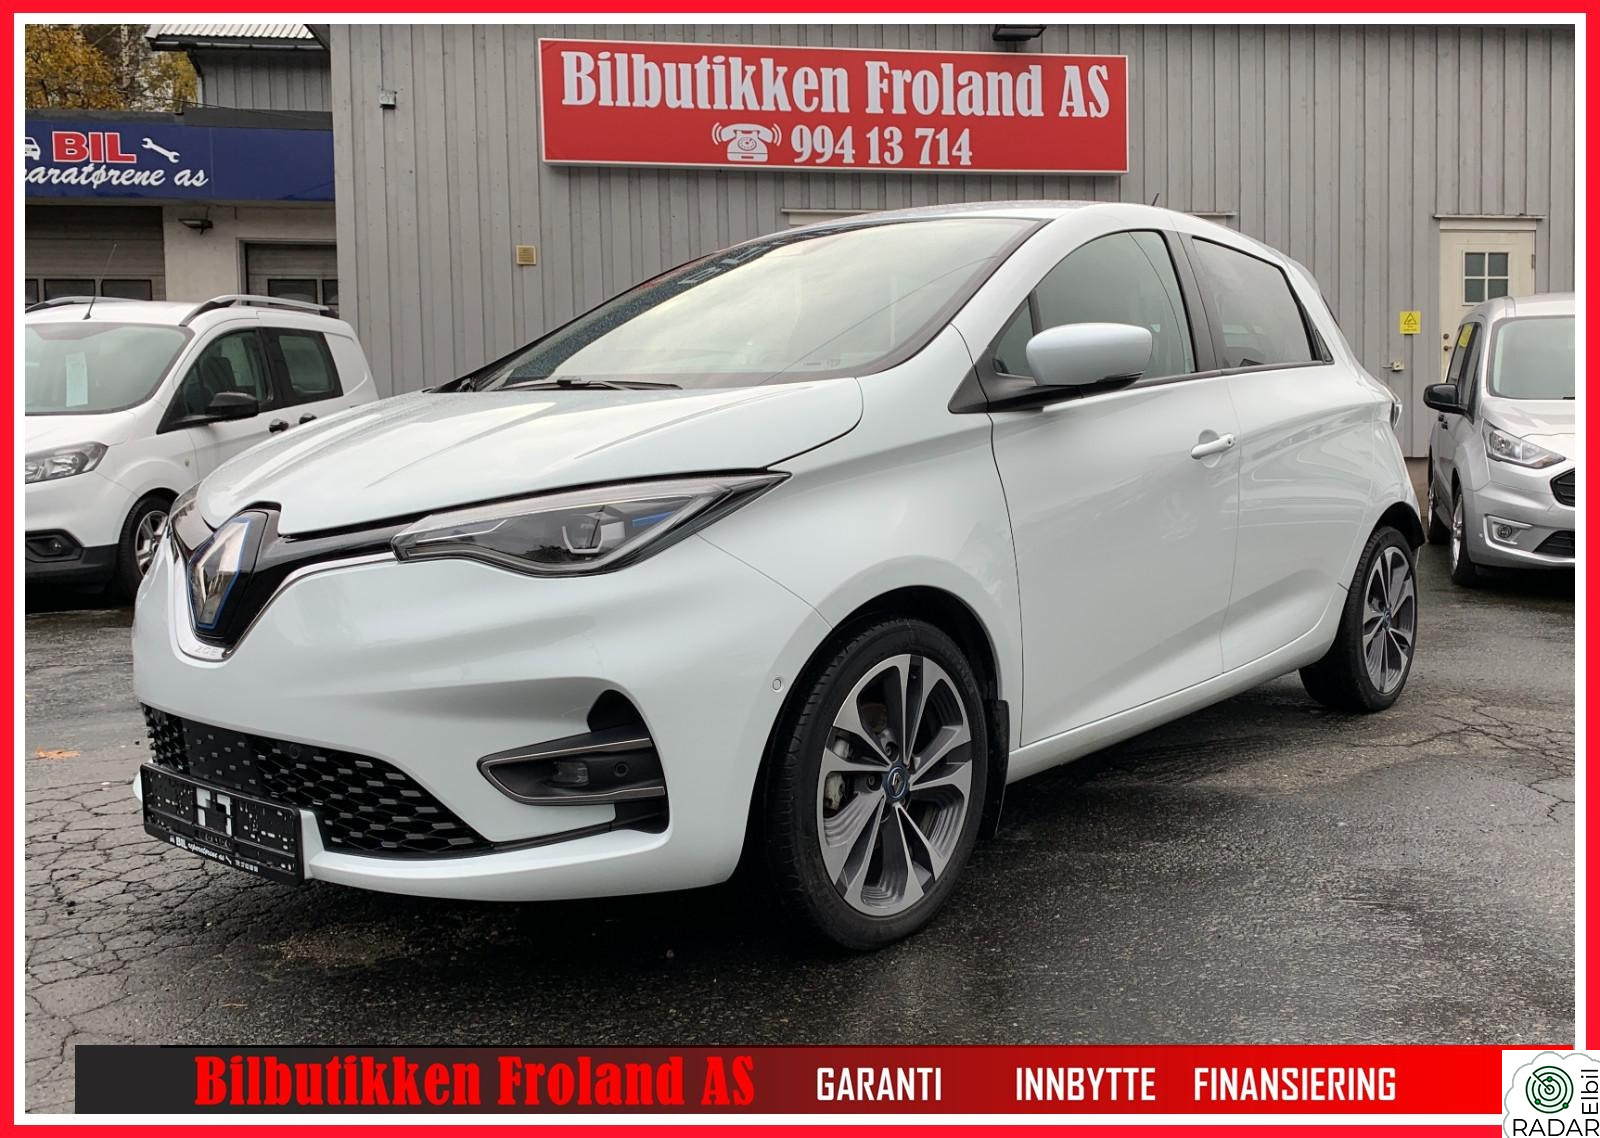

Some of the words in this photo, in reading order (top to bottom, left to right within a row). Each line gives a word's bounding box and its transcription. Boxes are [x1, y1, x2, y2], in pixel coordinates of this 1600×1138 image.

[561, 51, 850, 113] Bilbutikken
[865, 60, 1045, 117] Froland
[1058, 64, 1111, 118] AS
[52, 131, 137, 164] BIL
[791, 124, 856, 164] 994
[865, 126, 904, 165] 13
[914, 127, 973, 166] 714
[25, 163, 166, 189] aratørene
[173, 169, 209, 187] as
